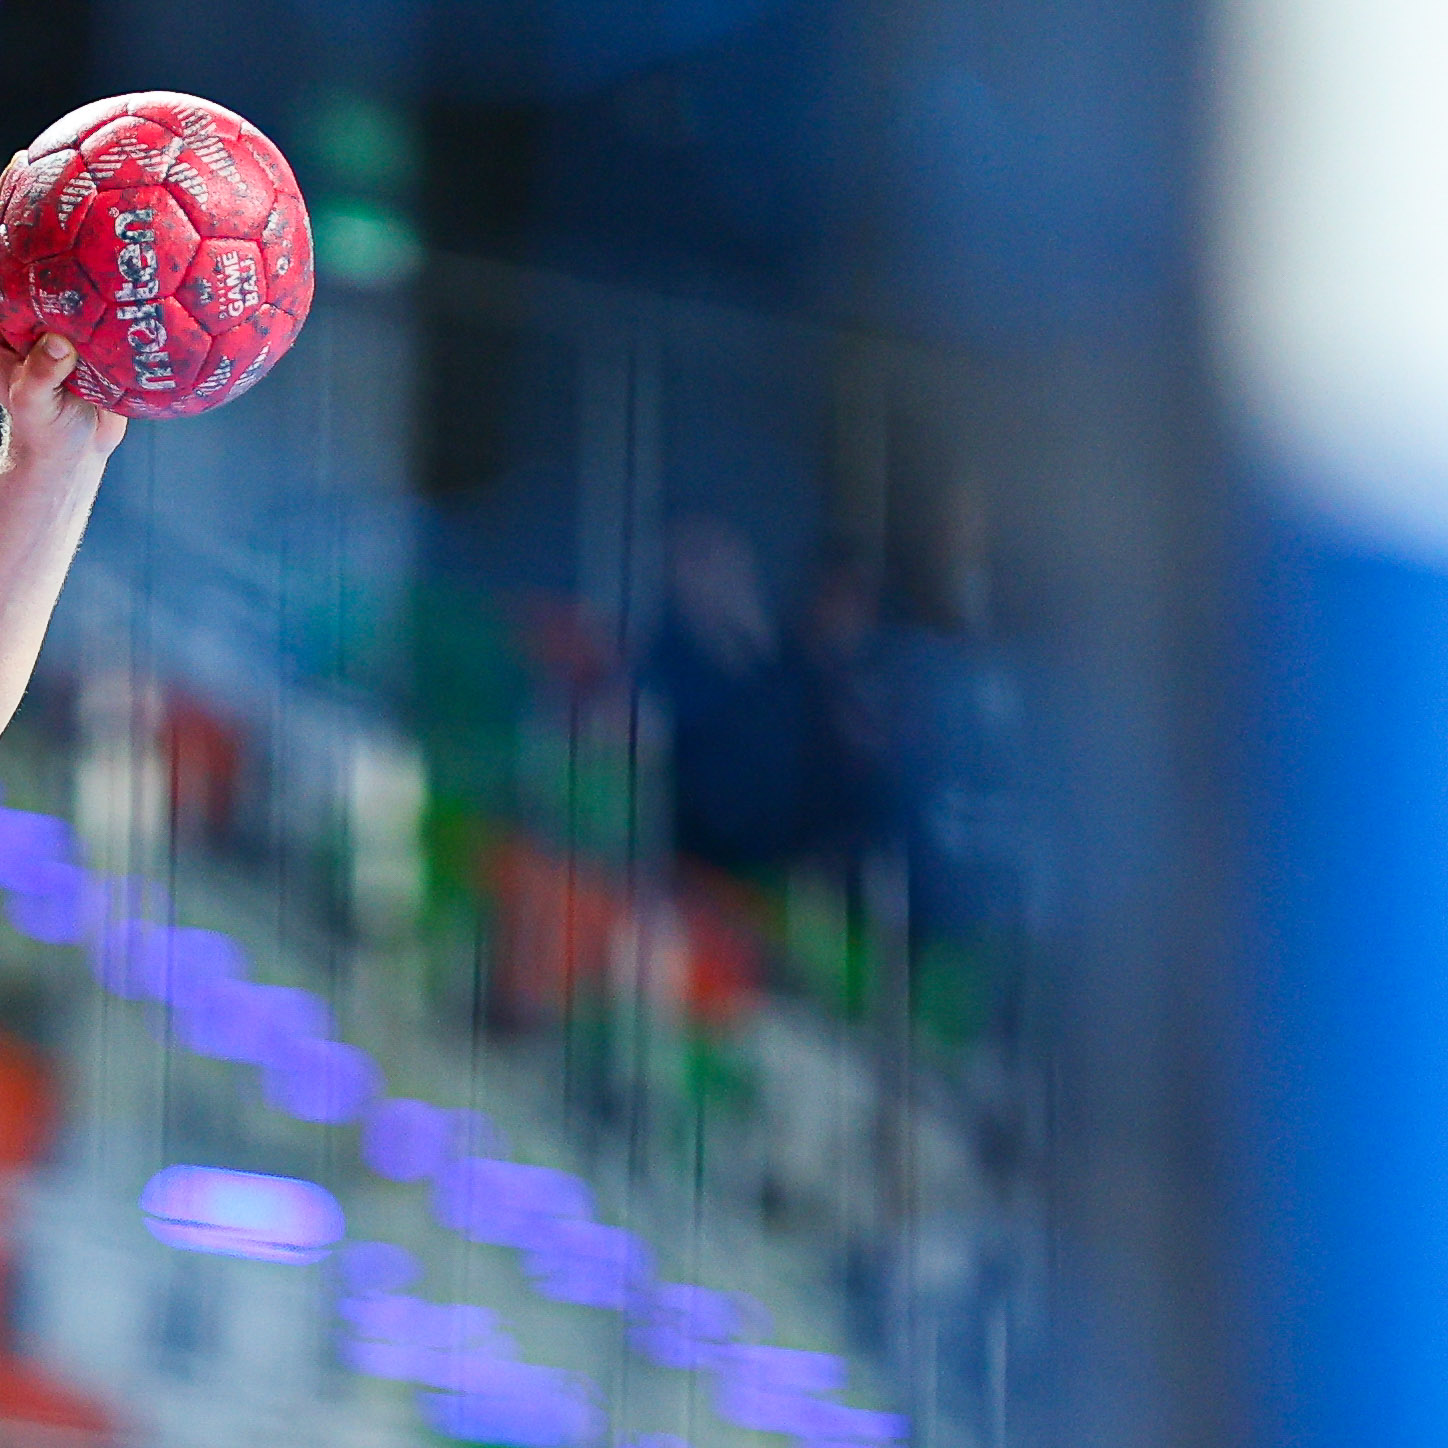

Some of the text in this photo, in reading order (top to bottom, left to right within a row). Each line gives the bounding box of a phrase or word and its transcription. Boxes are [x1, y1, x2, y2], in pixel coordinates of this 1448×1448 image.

[113, 206, 176, 390] molten
[221, 250, 245, 317] GAME
[239, 254, 260, 307] BALL
